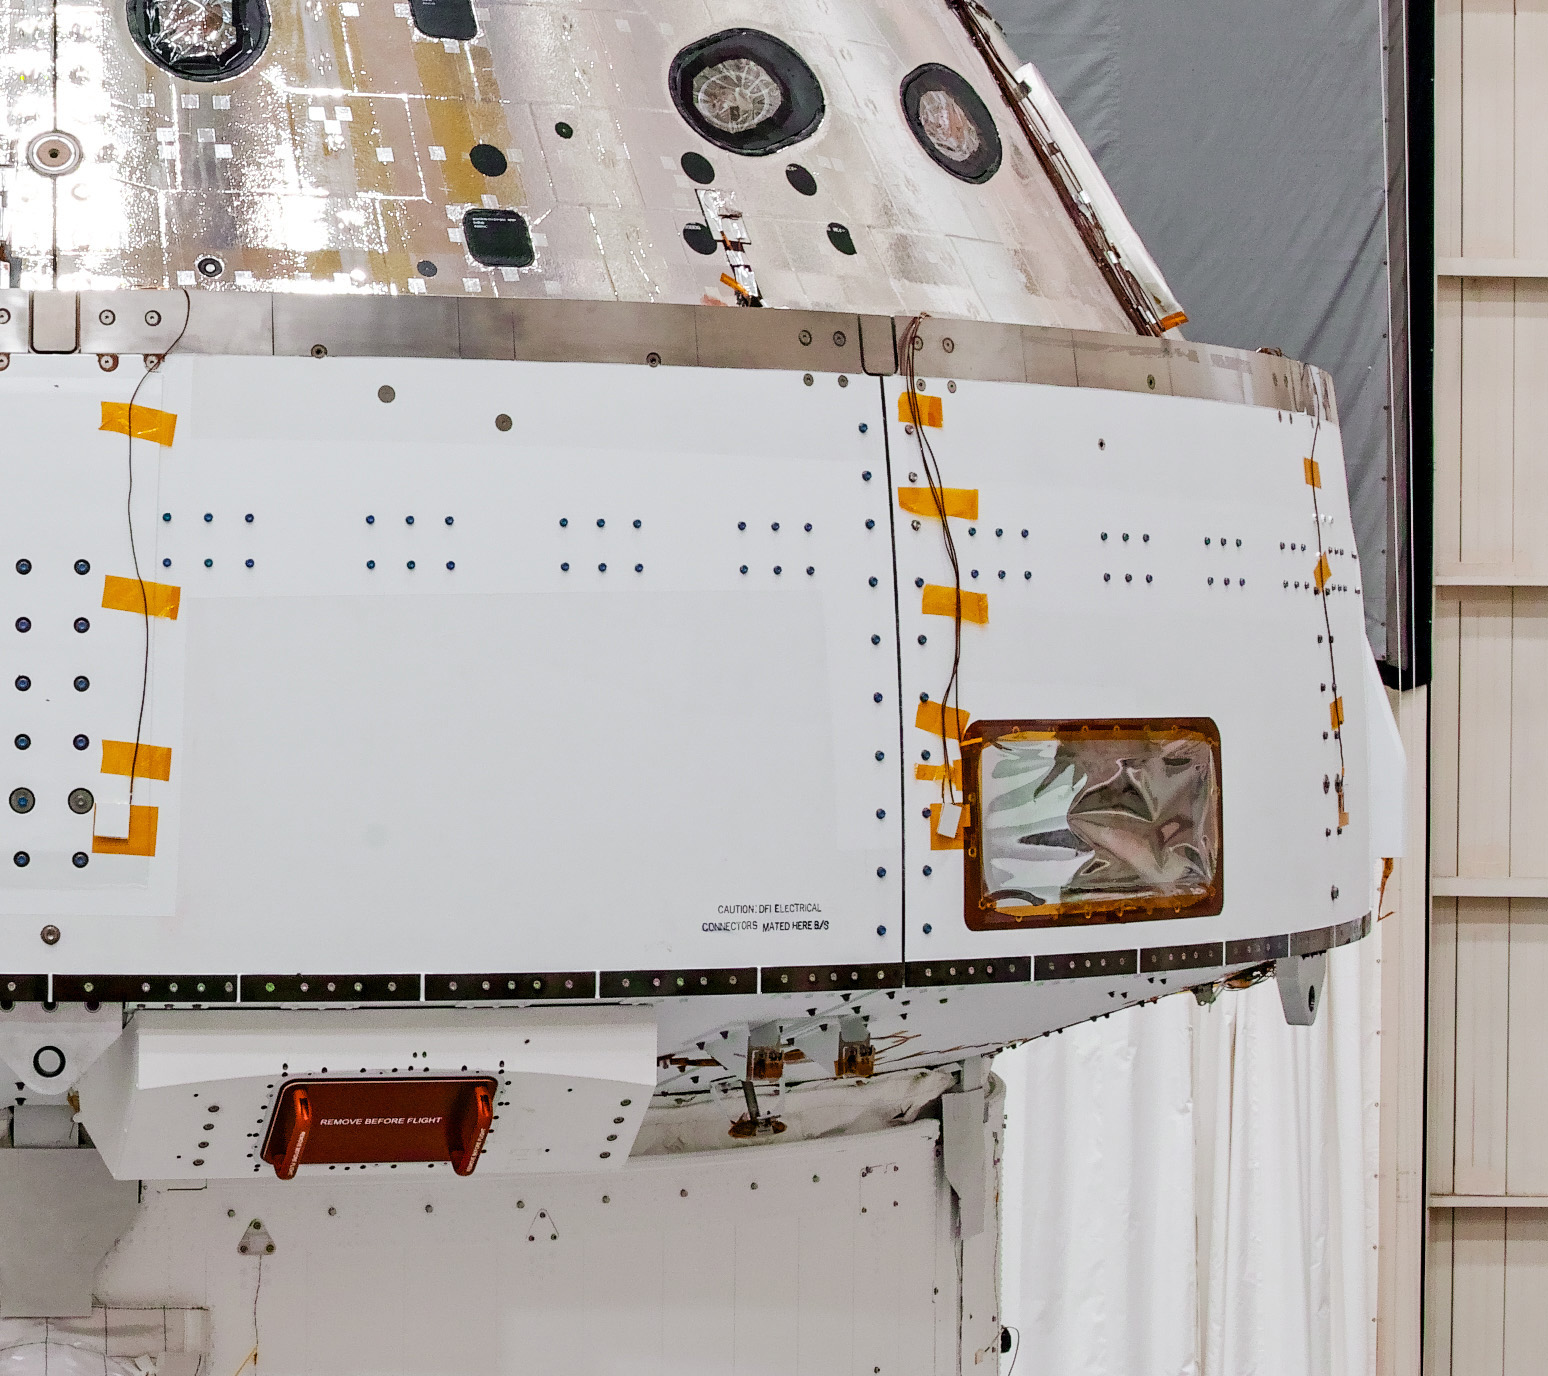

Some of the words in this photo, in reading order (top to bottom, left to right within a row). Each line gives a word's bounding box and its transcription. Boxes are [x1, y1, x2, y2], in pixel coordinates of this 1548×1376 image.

[717, 904, 758, 914] CAUTION:
[759, 904, 772, 914] DFI
[774, 903, 822, 913] ELECTRICAL
[701, 920, 758, 932] CONNECTORS
[762, 921, 791, 933] MATED
[791, 920, 813, 931] HERE
[813, 919, 830, 931] B/S
[320, 1118, 363, 1126] REMOVE
[364, 1117, 405, 1126] BEFORE
[406, 1116, 443, 1125] FLIGHT
